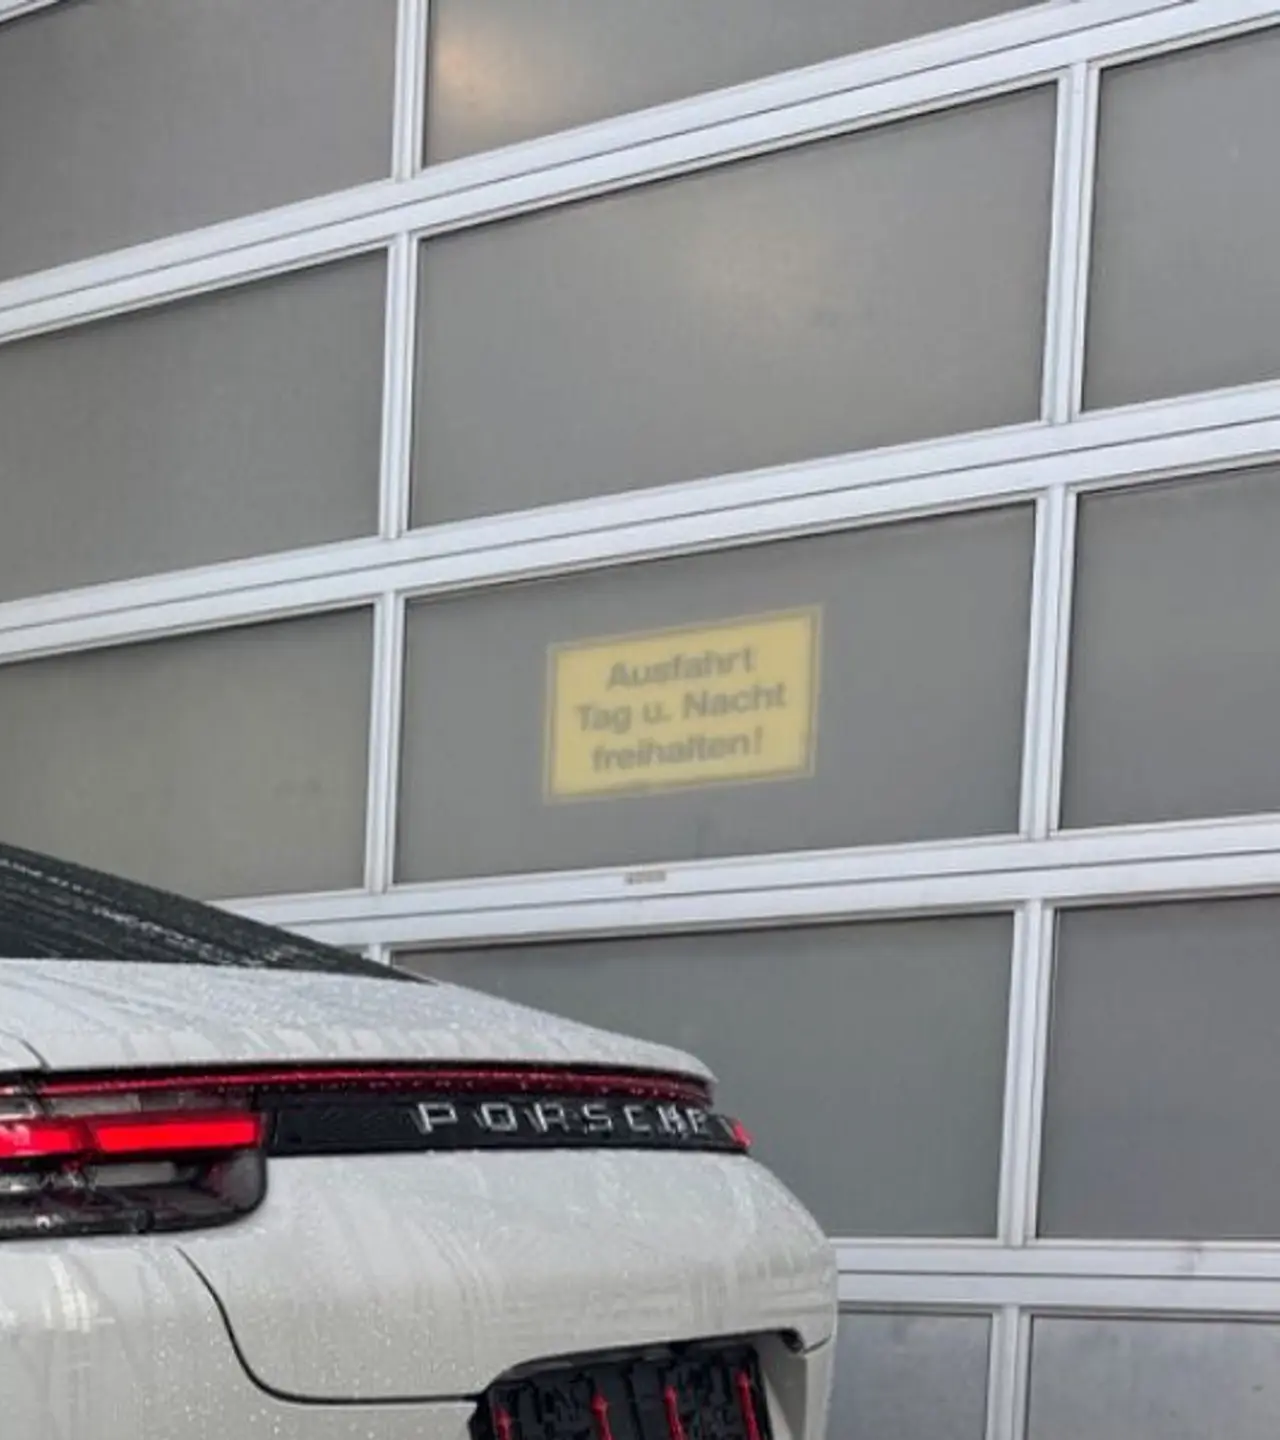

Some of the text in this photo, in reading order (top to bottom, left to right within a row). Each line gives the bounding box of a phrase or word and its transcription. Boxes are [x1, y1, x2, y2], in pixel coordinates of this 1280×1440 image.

[608, 649, 754, 689] Ausfahrt
[576, 682, 787, 734] Tag u. Nacht
[592, 726, 763, 771] freihalten!
[412, 1102, 711, 1137] PORSCHE
